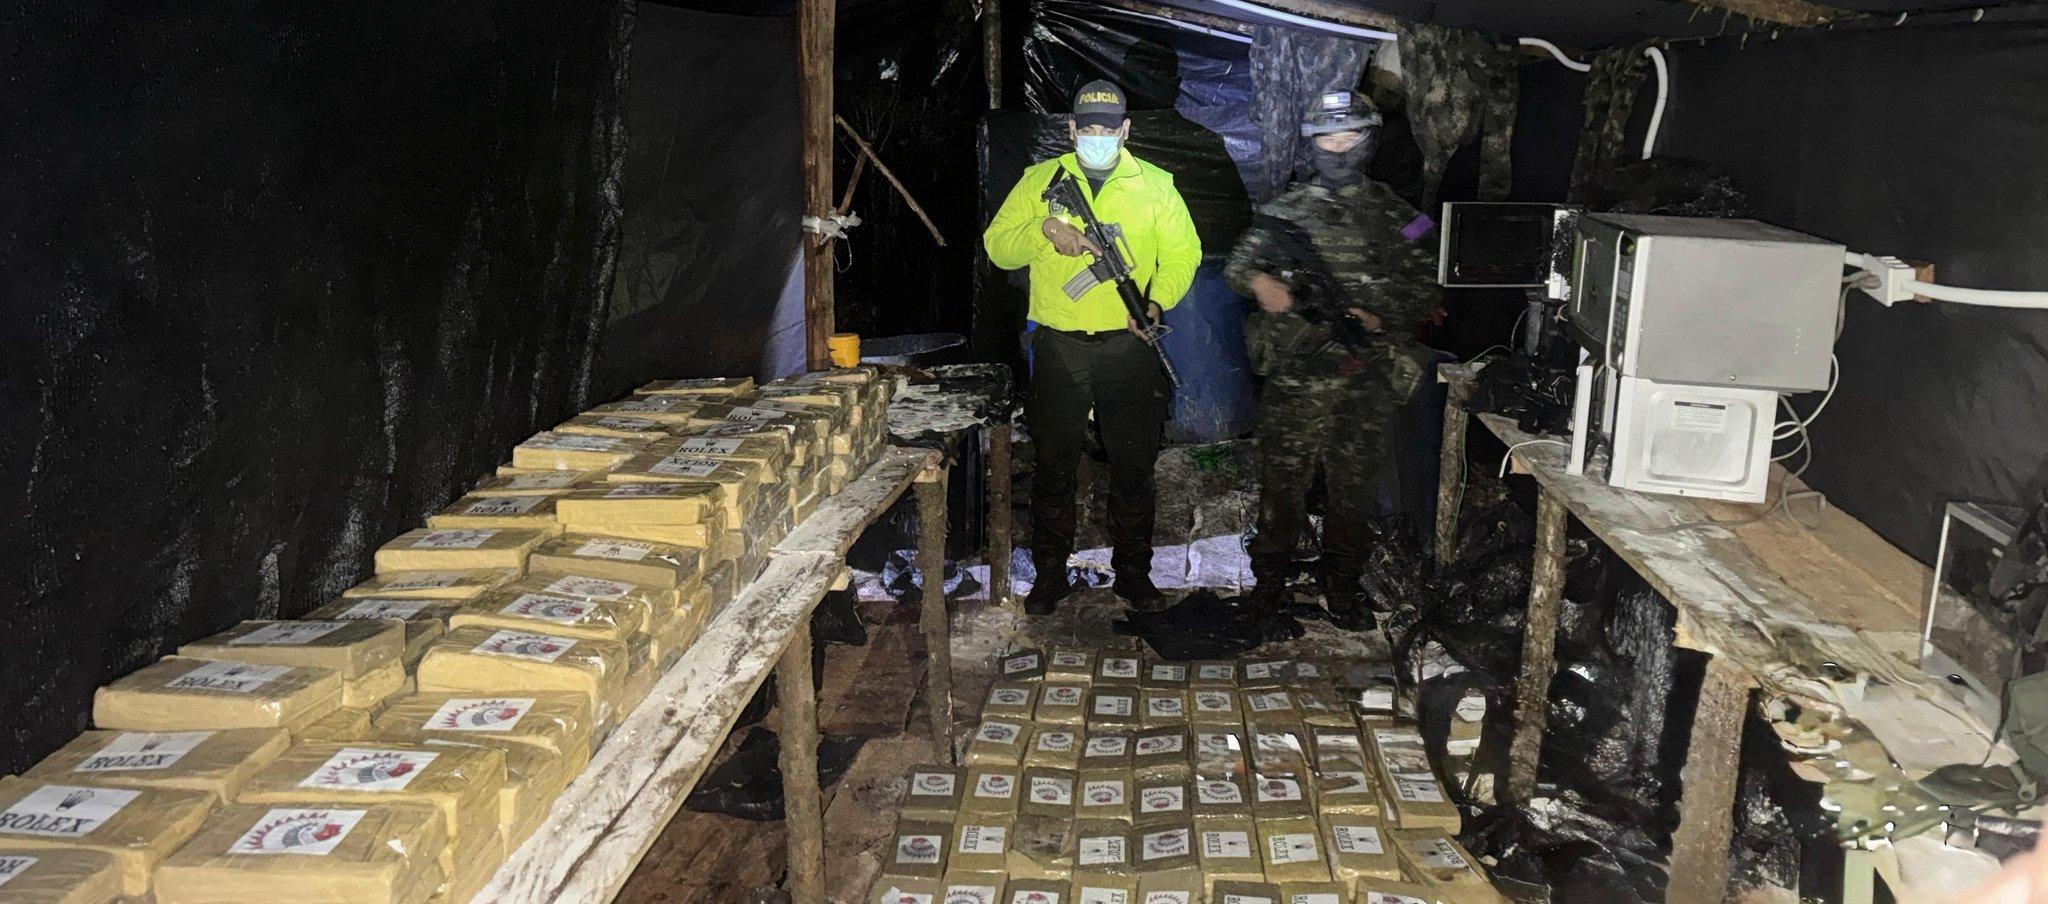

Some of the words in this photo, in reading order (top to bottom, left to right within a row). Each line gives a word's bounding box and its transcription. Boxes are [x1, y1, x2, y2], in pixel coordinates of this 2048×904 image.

[671, 457, 718, 467] ROLEX
[472, 505, 524, 514] ROLEX
[174, 676, 252, 690] ROLEX
[84, 753, 174, 769] ROLEX
[963, 826, 980, 850] ROLEX
[1206, 832, 1221, 854] ROLEX
[1335, 826, 1354, 850] ROLEX
[1272, 836, 1289, 860] ROLEX
